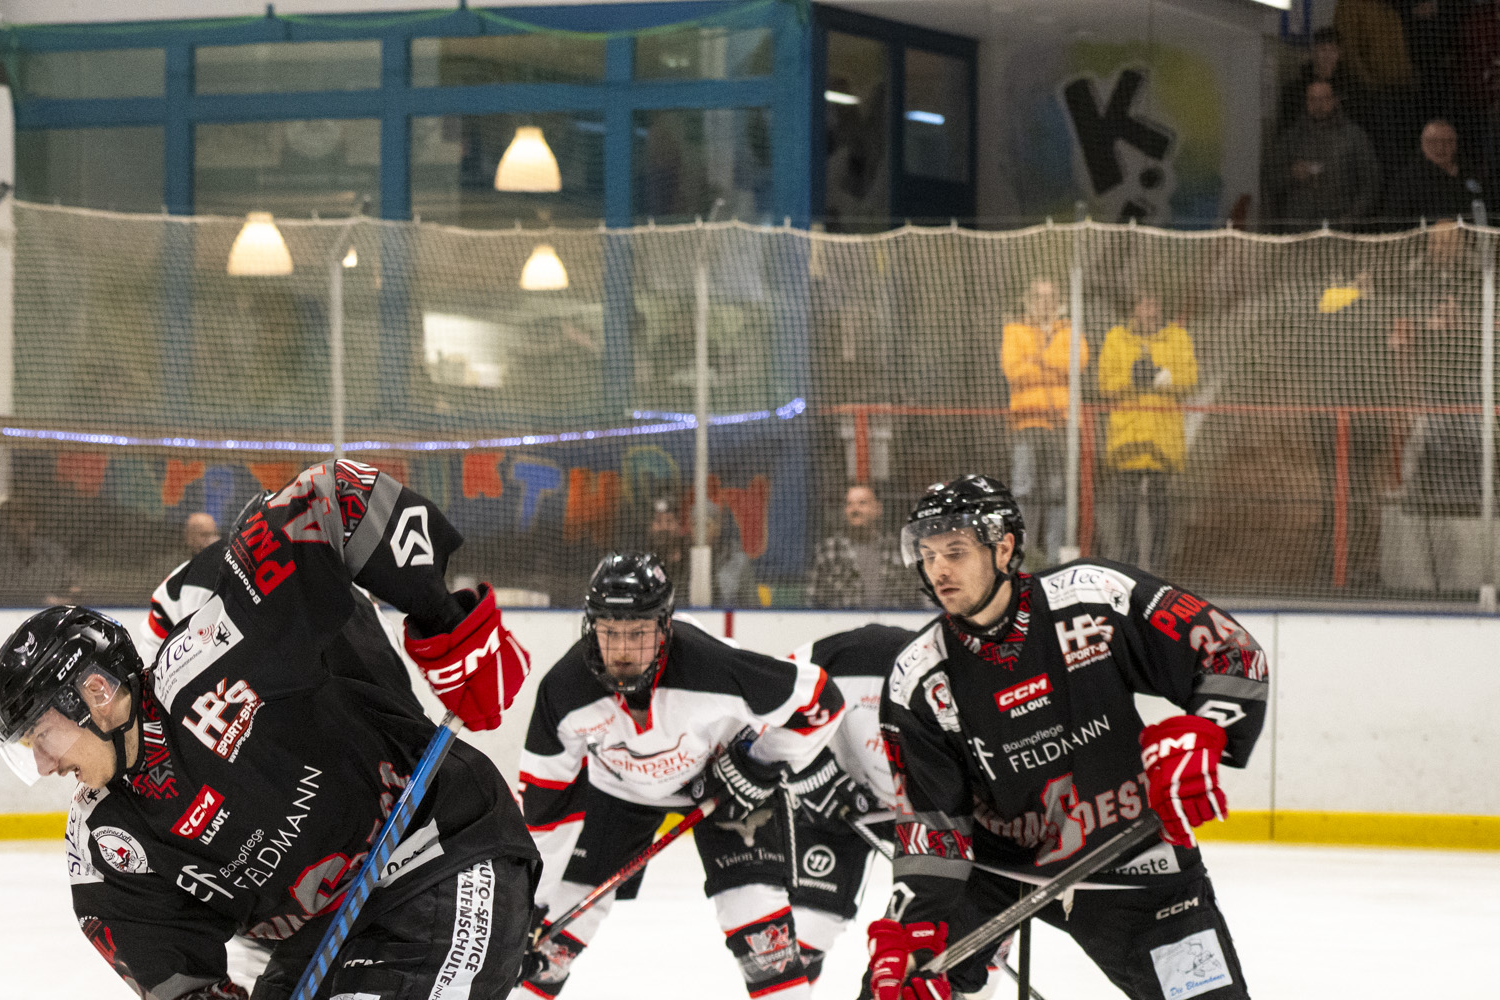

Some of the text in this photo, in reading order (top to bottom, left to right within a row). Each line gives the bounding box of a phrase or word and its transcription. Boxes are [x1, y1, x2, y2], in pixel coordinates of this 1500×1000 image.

[56, 648, 83, 682] CCM
[421, 626, 501, 685] CM
[999, 679, 1049, 708] CCM
[1002, 723, 1065, 756] Baumpflege
[1142, 732, 1197, 766] CM
[180, 790, 217, 835] CCM
[715, 848, 785, 869] Vision Town
[1155, 896, 1199, 920] CCM
